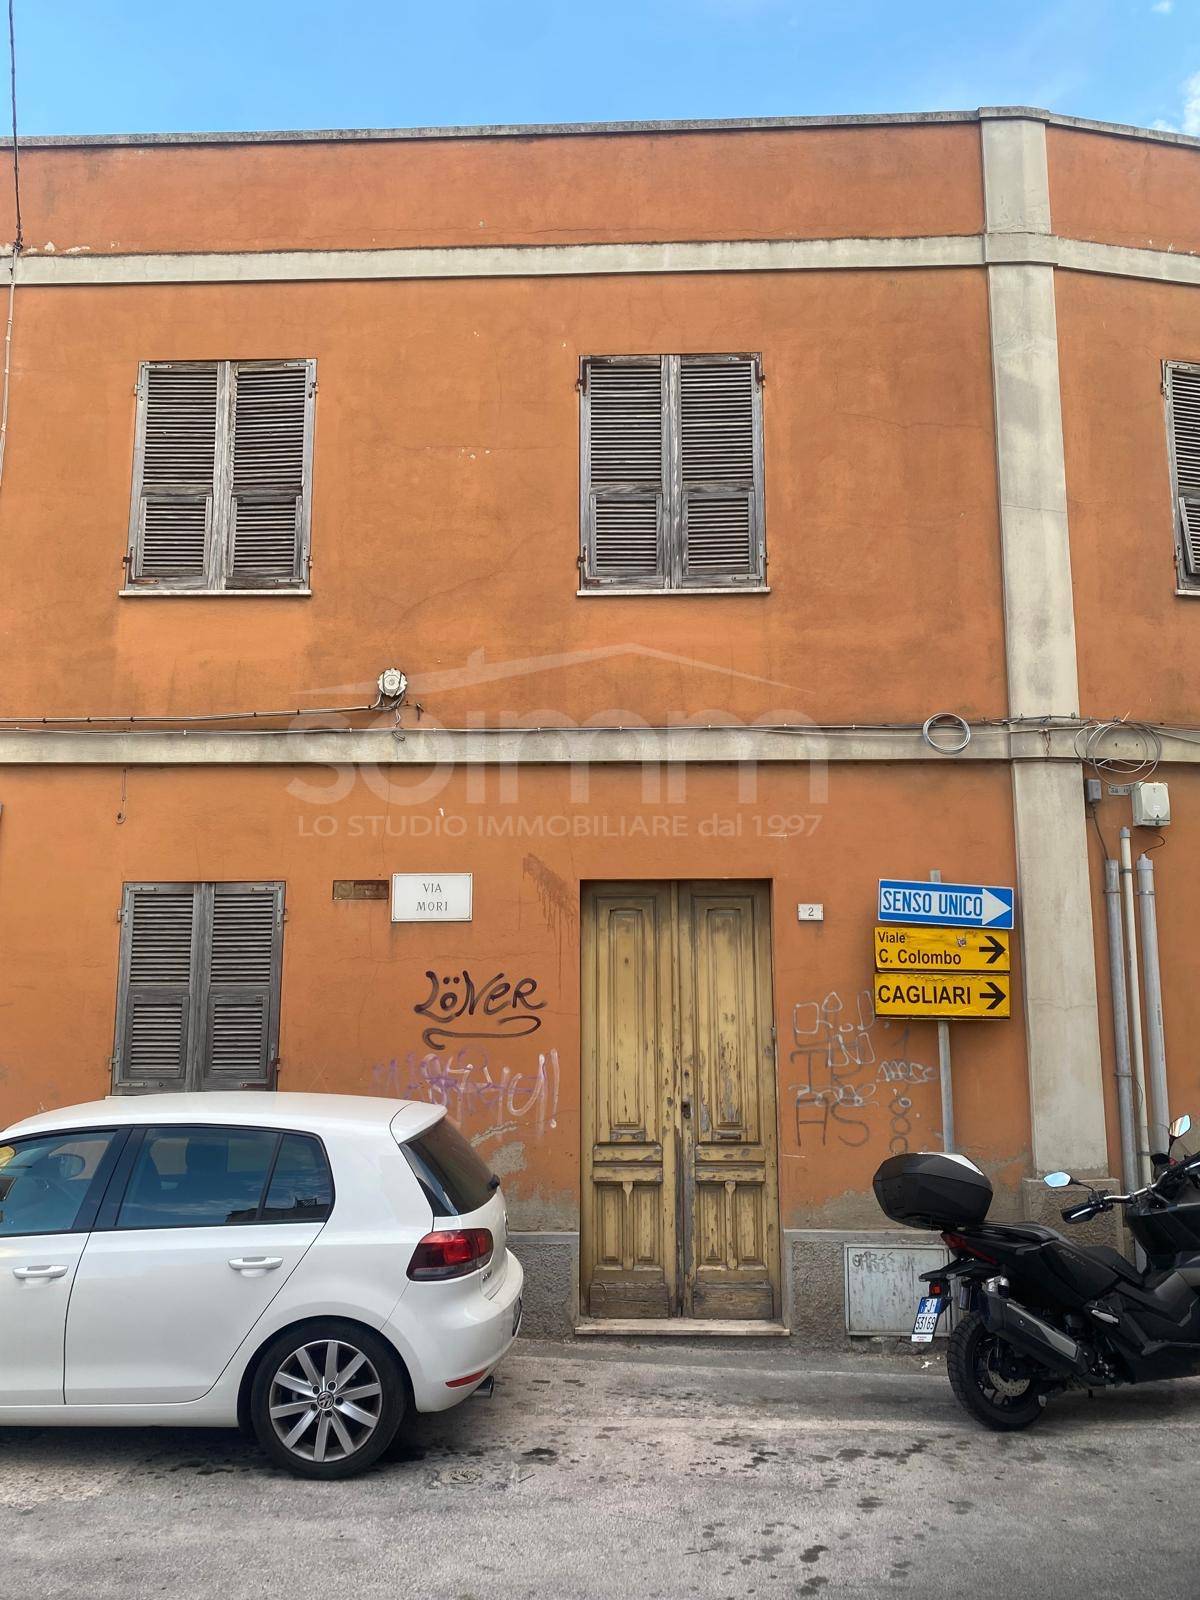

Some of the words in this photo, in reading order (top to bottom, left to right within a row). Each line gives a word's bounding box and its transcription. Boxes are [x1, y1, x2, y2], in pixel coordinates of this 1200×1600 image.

[423, 882, 442, 893] VIA
[416, 901, 449, 912] MORI
[882, 889, 932, 914] SENSO
[938, 893, 983, 917] UNICO
[808, 906, 814, 917] 2
[877, 931, 906, 944] Viale
[878, 948, 893, 964] C.
[897, 949, 962, 965] Colombo
[877, 984, 971, 1005] CAGLIARI
